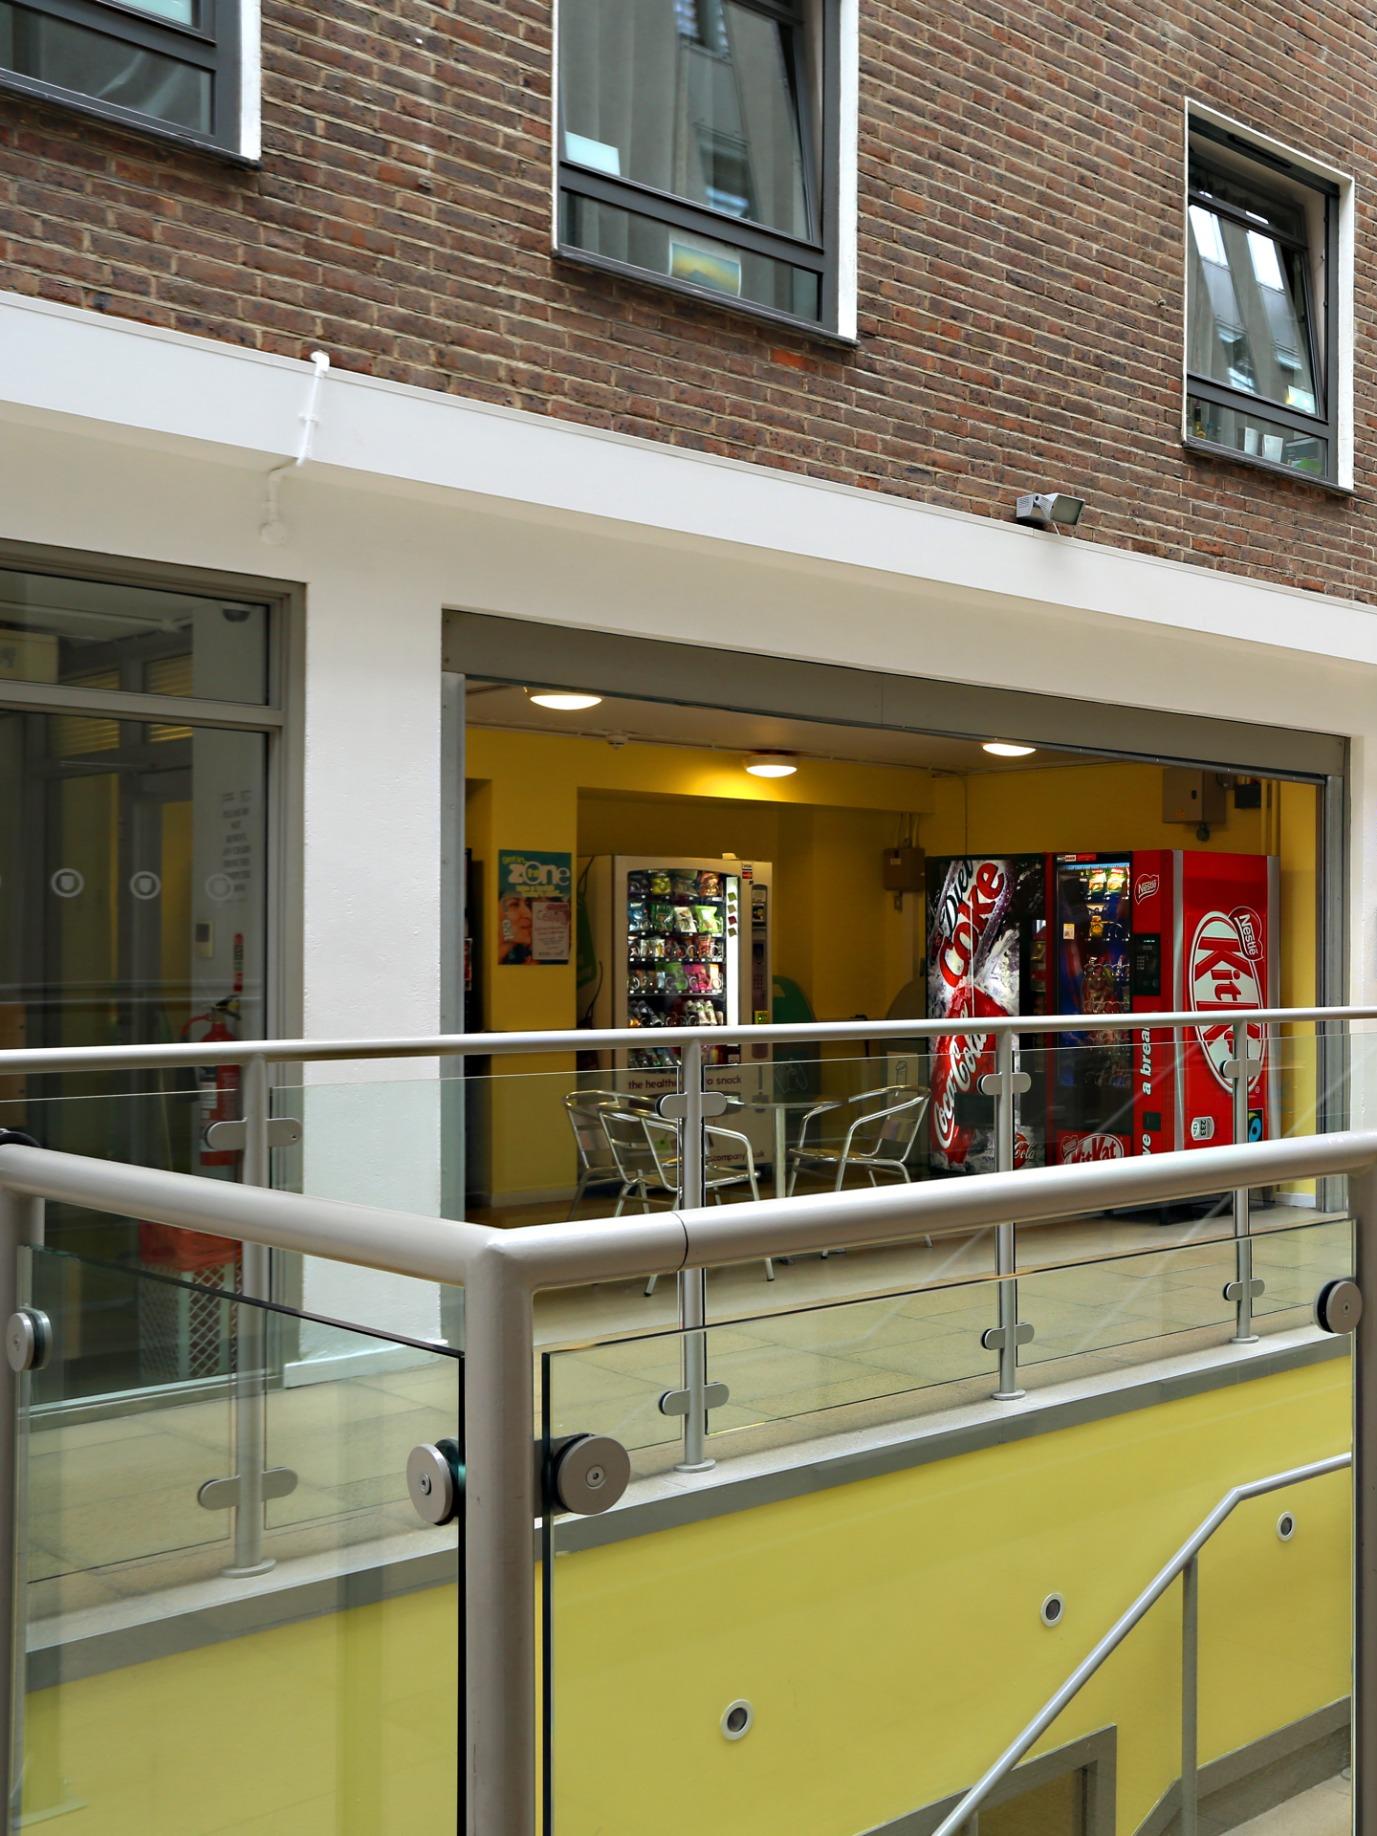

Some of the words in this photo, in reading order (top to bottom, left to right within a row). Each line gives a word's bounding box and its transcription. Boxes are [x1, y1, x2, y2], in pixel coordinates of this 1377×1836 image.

[939, 862, 1005, 988] Coke
[1140, 1028, 1152, 1077] brea
[716, 1074, 742, 1085] snack
[1142, 1082, 1152, 1095] a
